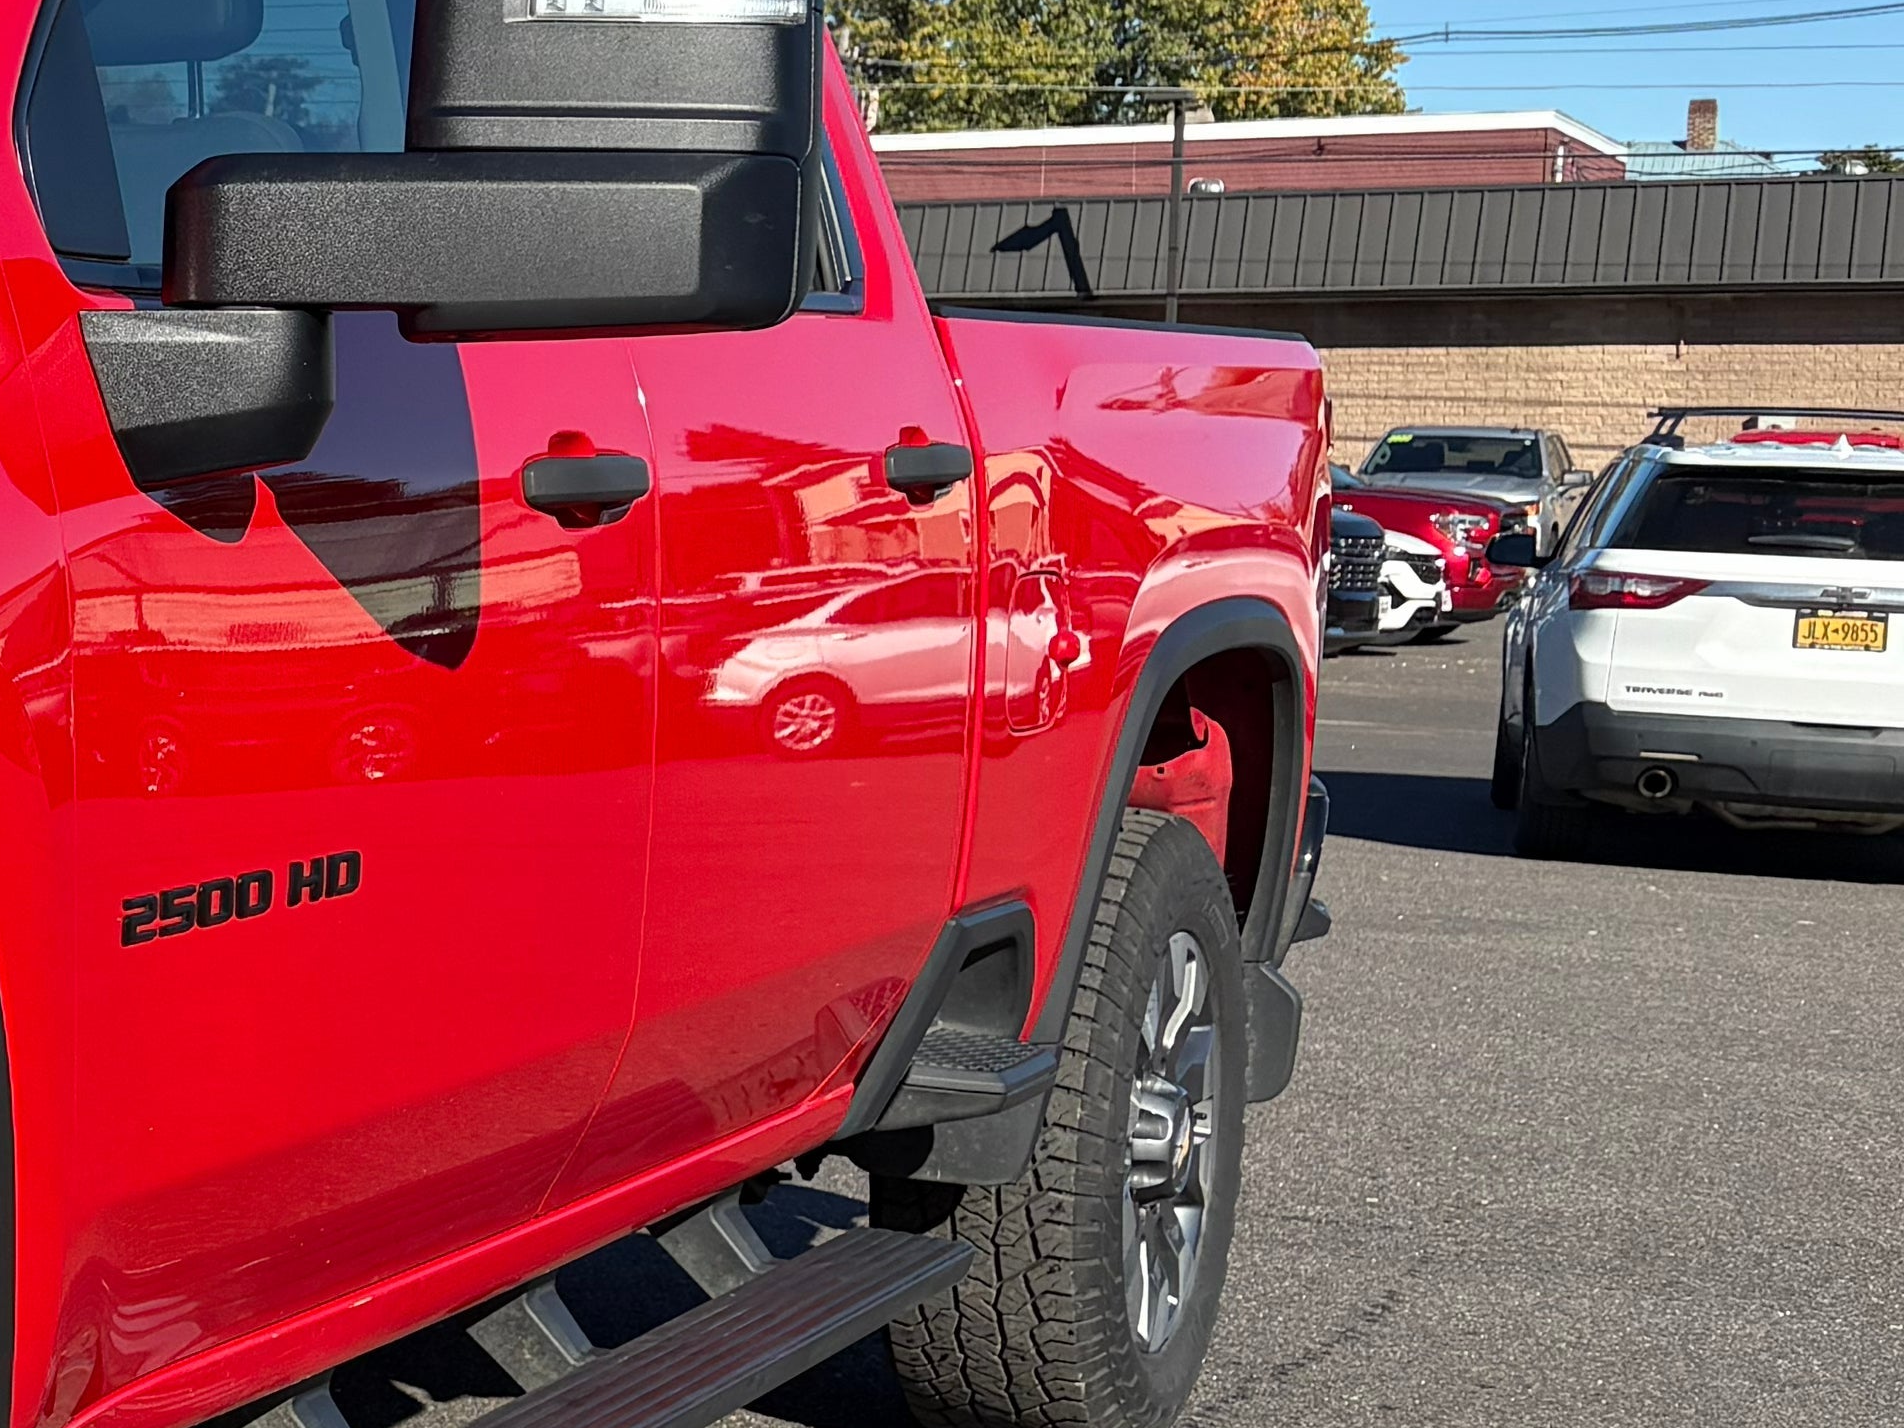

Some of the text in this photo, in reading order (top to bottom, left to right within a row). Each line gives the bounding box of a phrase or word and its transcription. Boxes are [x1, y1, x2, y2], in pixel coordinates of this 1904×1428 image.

[1801, 619, 1879, 644] JLX 9855
[120, 849, 362, 948] 2500 HD
